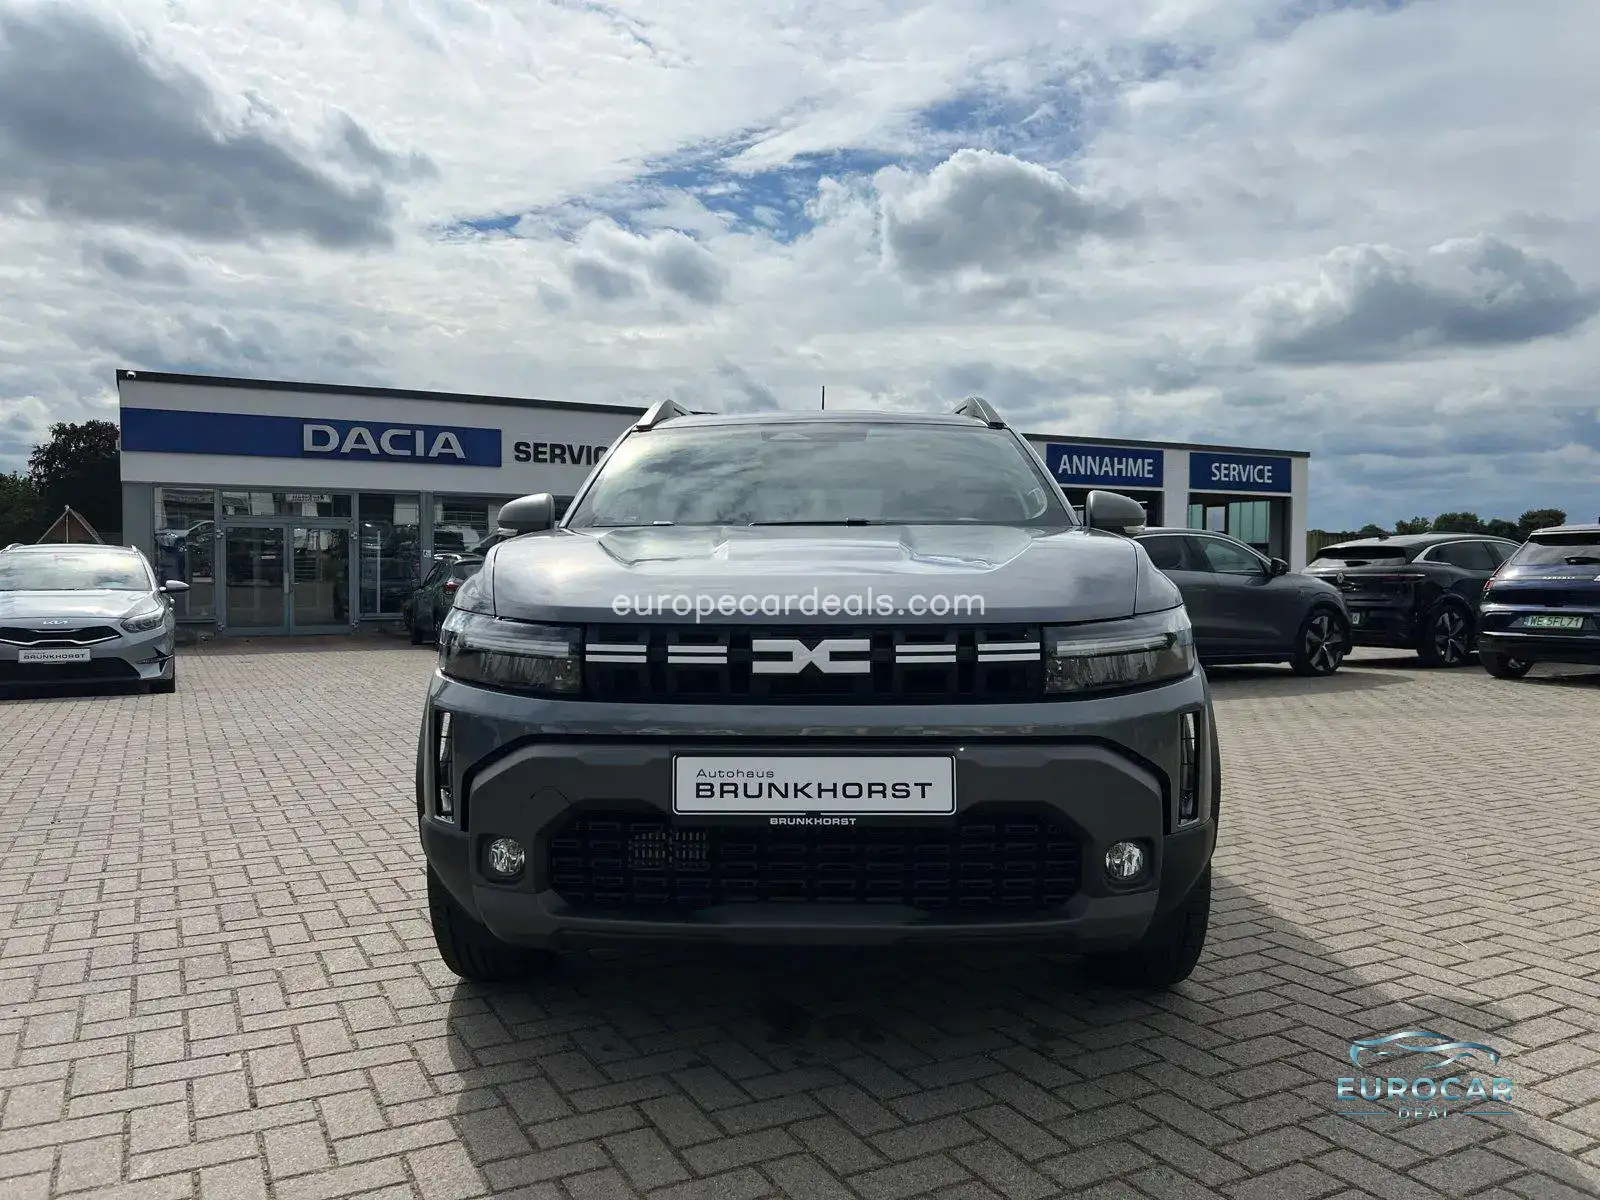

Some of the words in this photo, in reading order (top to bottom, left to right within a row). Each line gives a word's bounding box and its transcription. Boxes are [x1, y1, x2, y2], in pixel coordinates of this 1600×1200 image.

[303, 424, 466, 459] DACIA
[1058, 454, 1154, 478] ANNAHME
[1211, 462, 1273, 483] SERVICE
[696, 768, 774, 778] Autohaus
[695, 782, 933, 799] BRUNKHORST
[769, 817, 857, 826] BRUNKHORST
